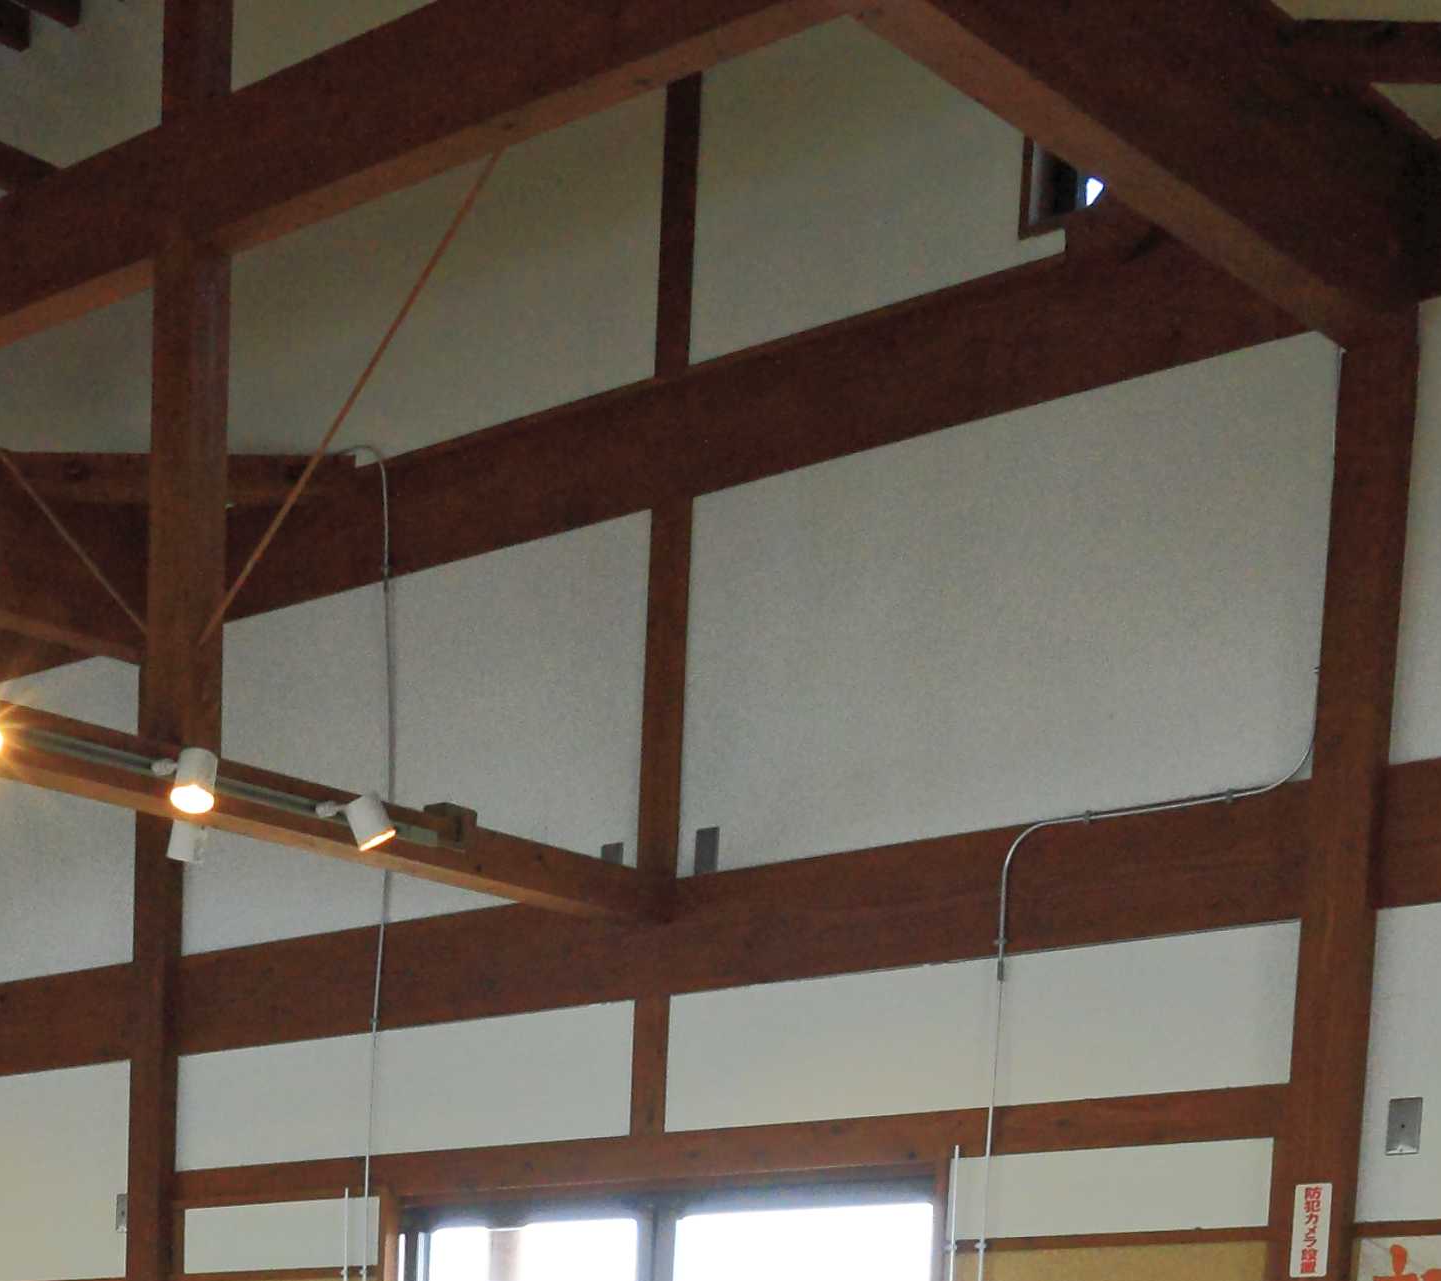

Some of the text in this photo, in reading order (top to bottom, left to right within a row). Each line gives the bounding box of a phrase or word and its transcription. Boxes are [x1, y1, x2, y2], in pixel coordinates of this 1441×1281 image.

[1301, 1185, 1321, 1275] 防犯カメラ設置
